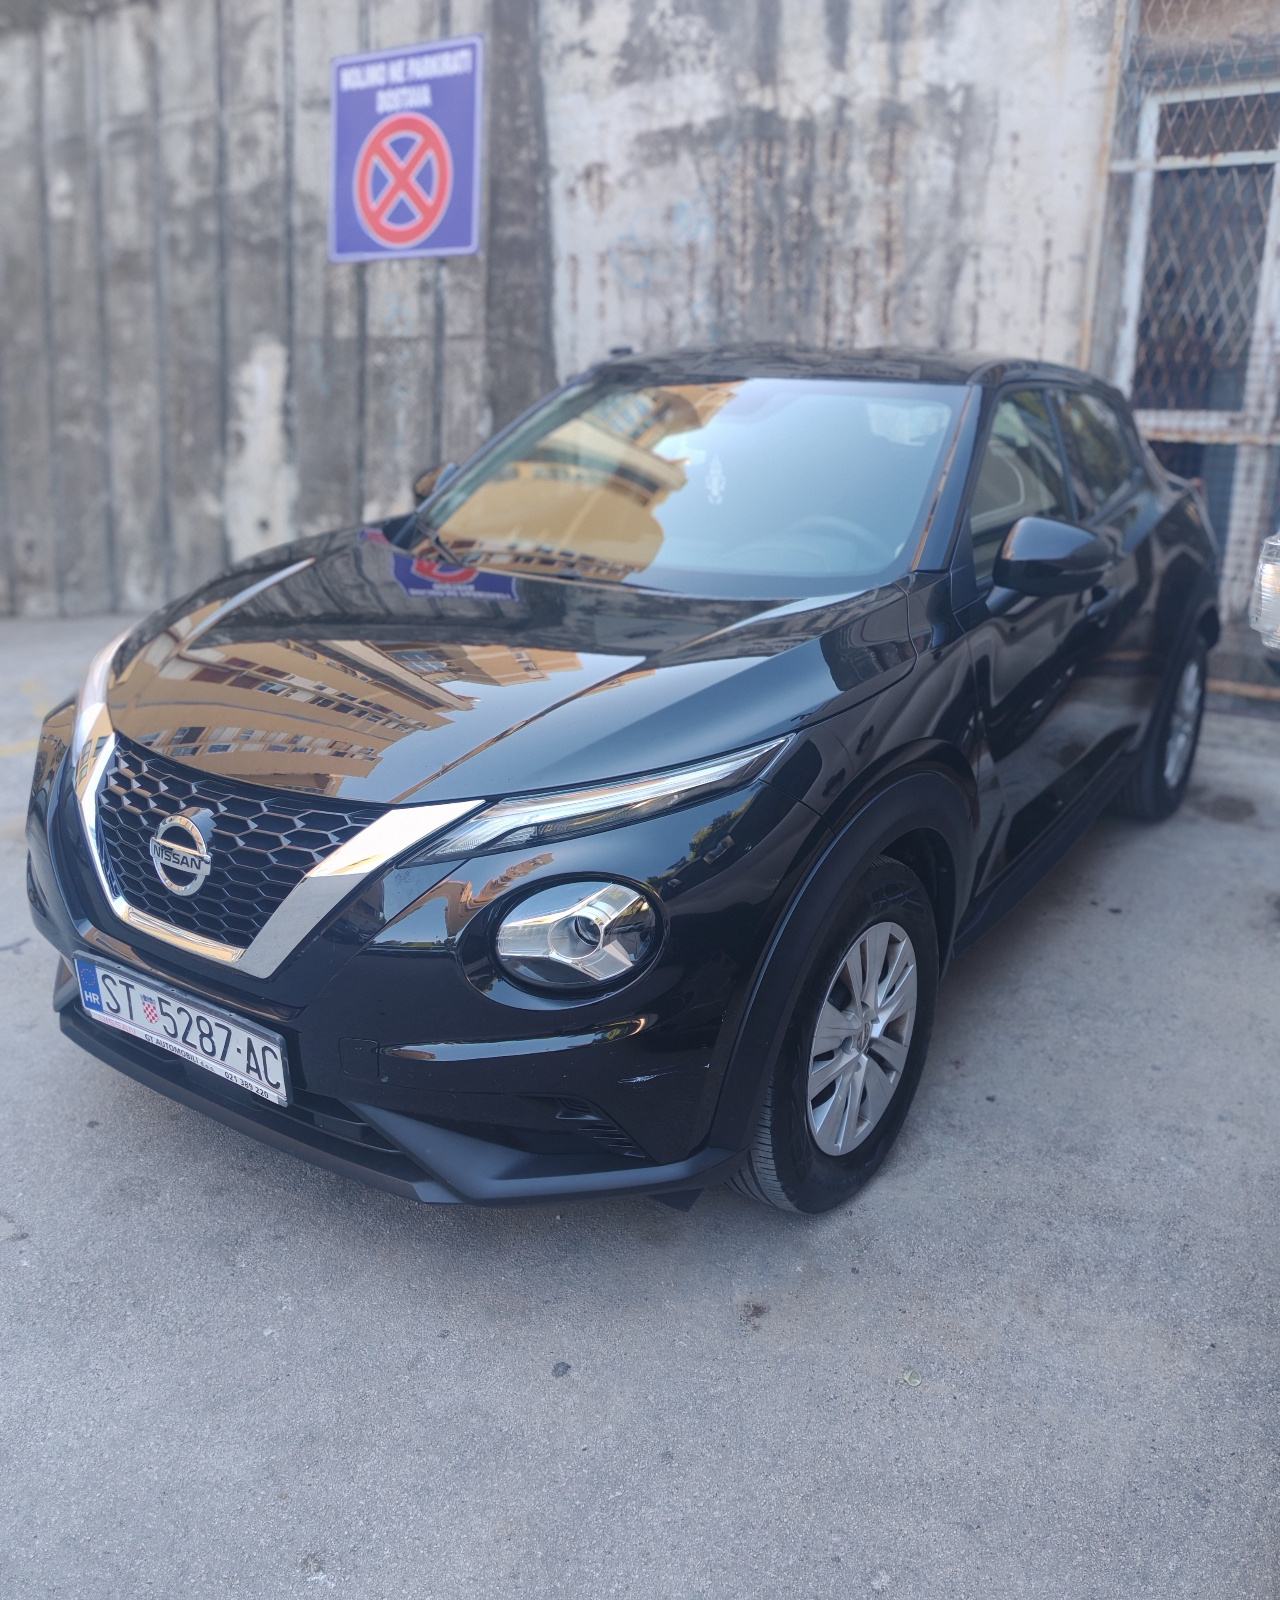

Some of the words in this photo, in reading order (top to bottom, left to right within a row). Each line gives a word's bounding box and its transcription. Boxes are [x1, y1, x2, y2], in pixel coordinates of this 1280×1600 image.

[153, 844, 202, 870] NISSAN
[84, 990, 101, 1004] HR
[101, 973, 136, 1021] ST
